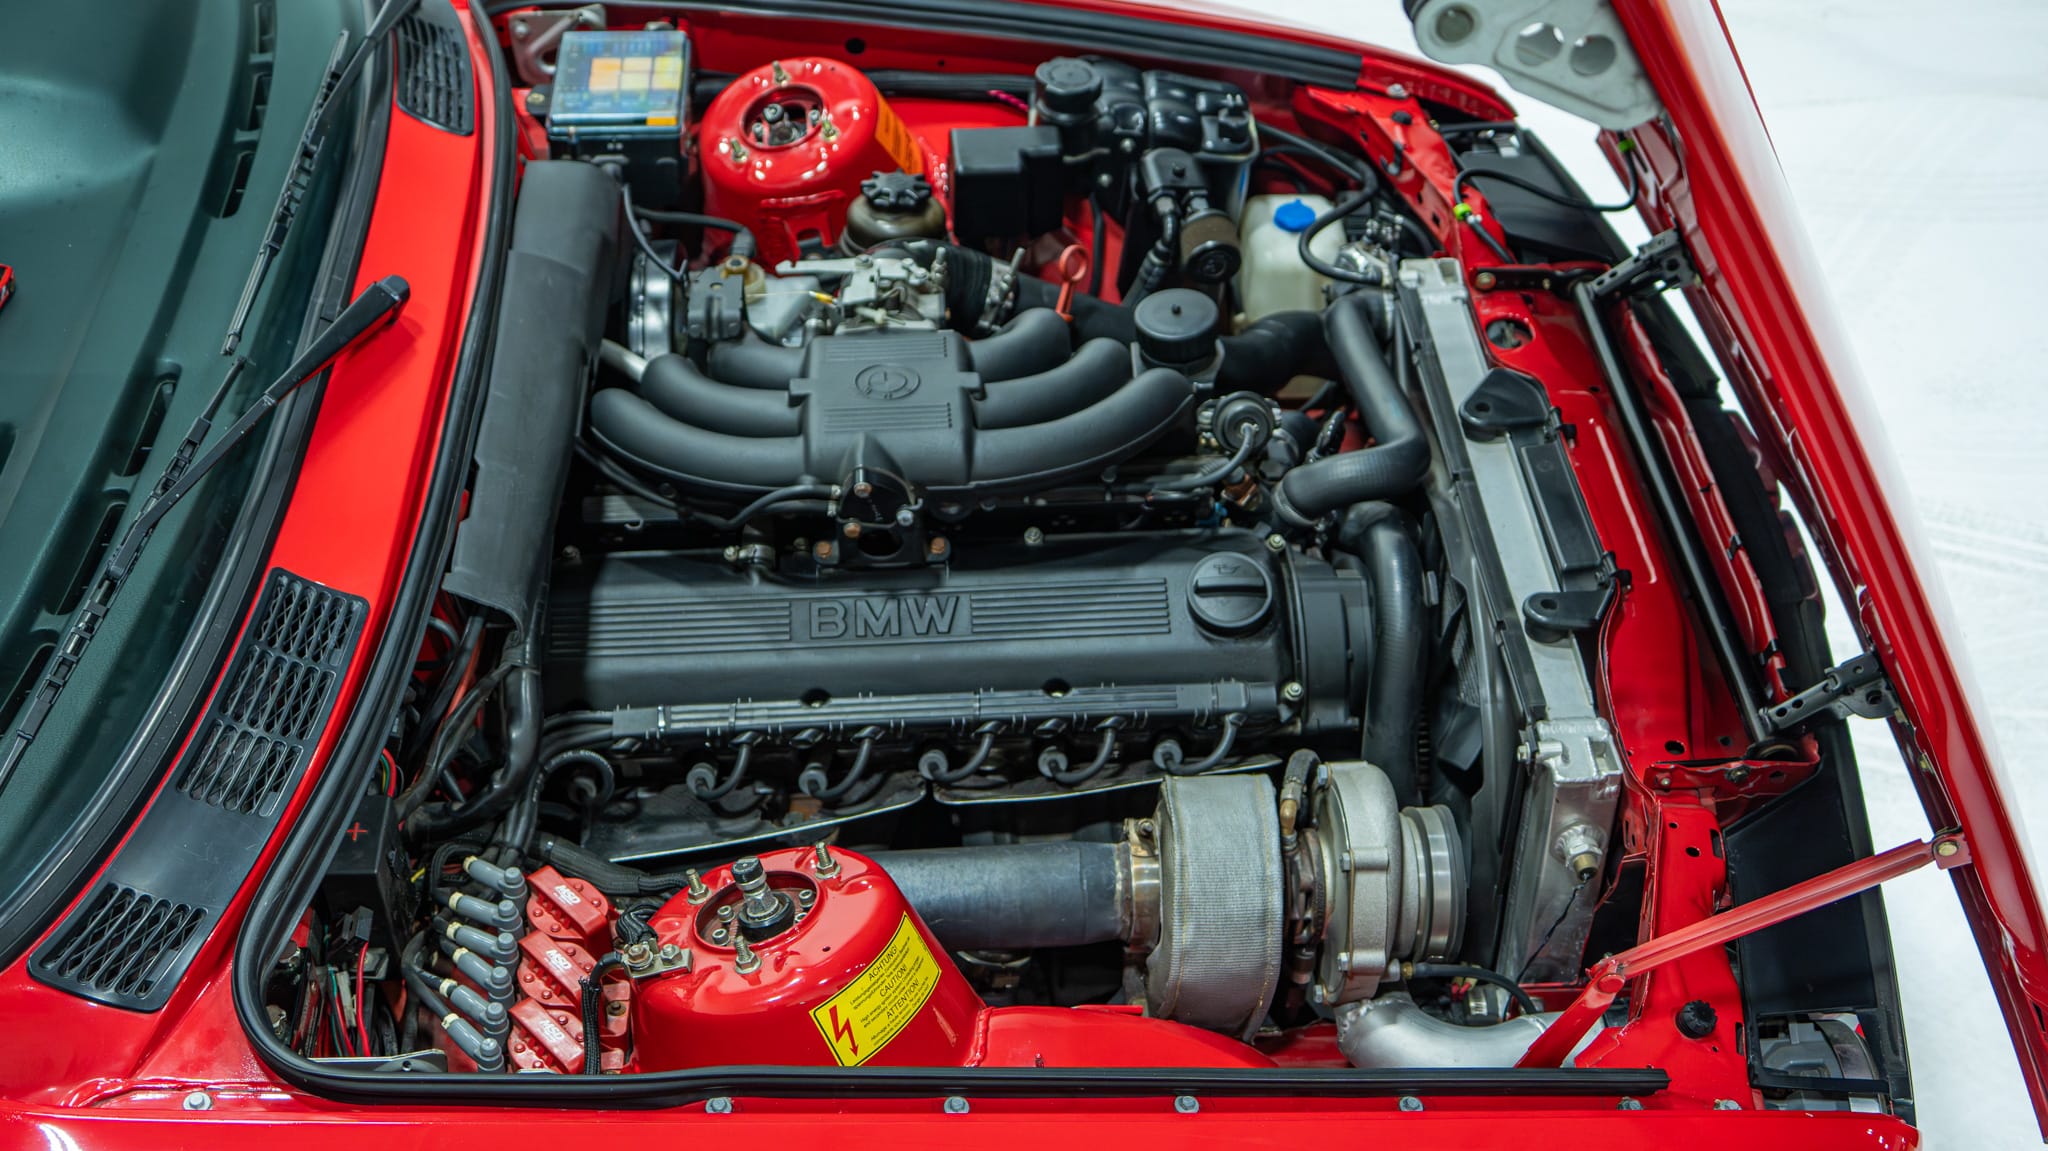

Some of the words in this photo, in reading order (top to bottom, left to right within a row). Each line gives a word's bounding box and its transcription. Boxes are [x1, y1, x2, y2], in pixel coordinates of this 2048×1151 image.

[809, 595, 960, 640] BMW
[554, 884, 581, 905] MSD
[545, 949, 572, 970] MSD
[868, 944, 898, 981] ACHTUNG!
[880, 964, 907, 997] CAUTION!
[886, 978, 919, 1019] ATTENTION!
[539, 1019, 565, 1041] MSD
